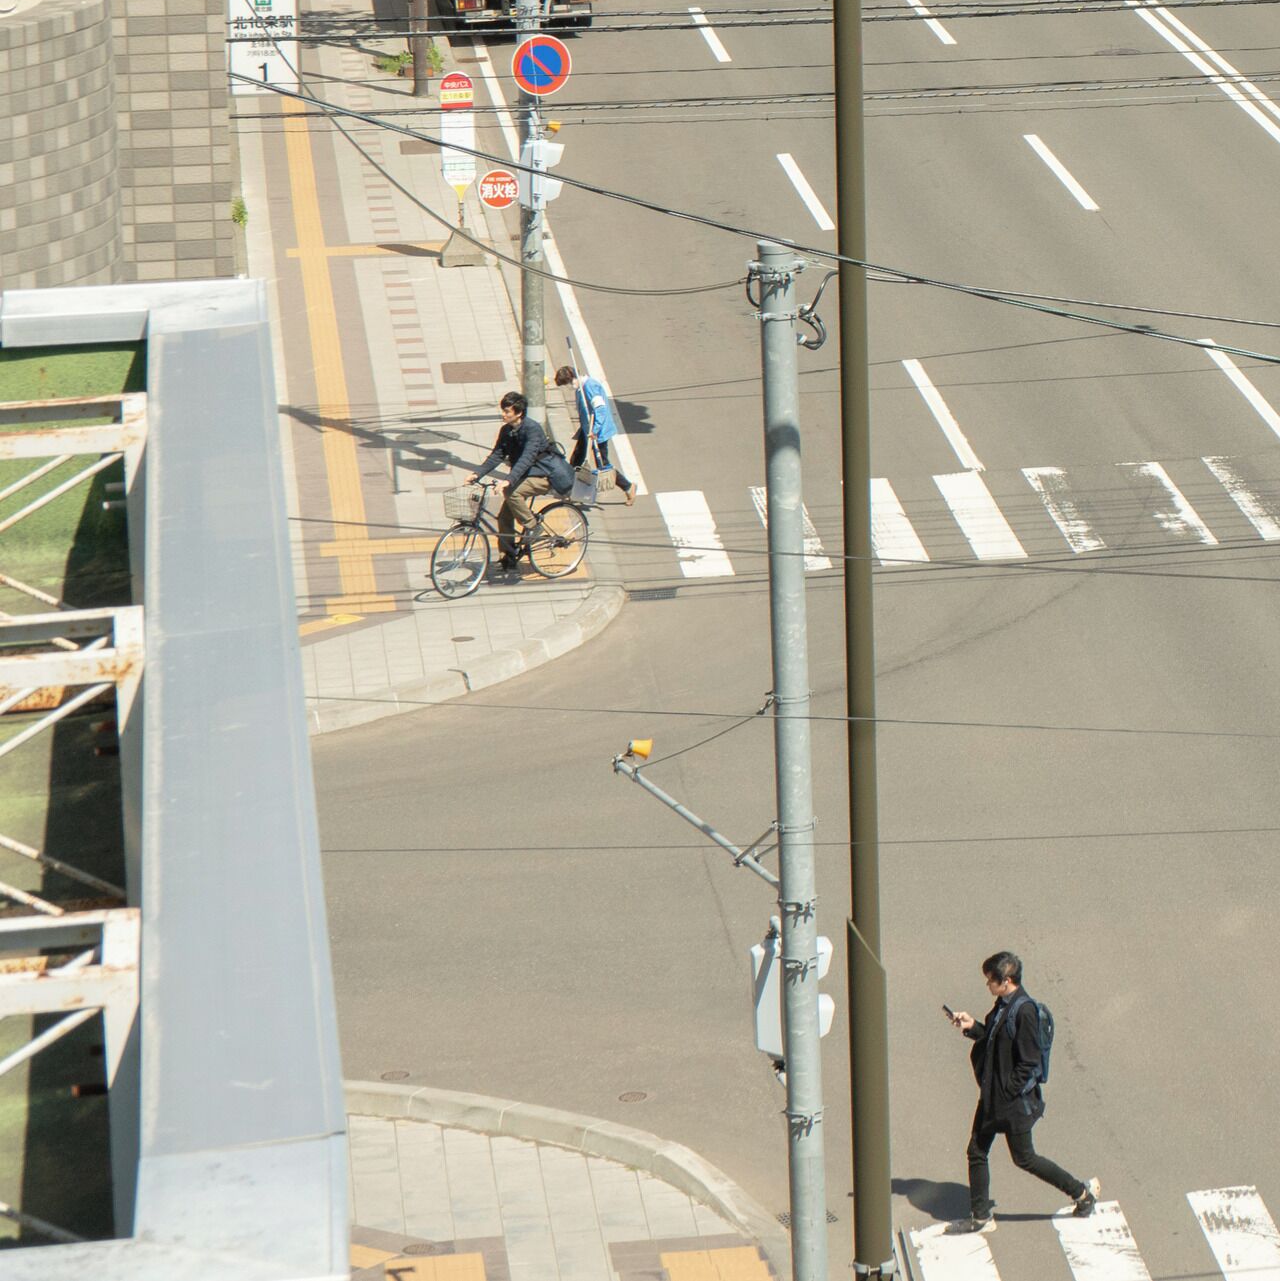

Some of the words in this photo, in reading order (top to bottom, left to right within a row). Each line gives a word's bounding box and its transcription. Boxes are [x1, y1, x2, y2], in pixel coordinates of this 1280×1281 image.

[257, 62, 268, 82] 1
[481, 183, 518, 199] 消火栓
